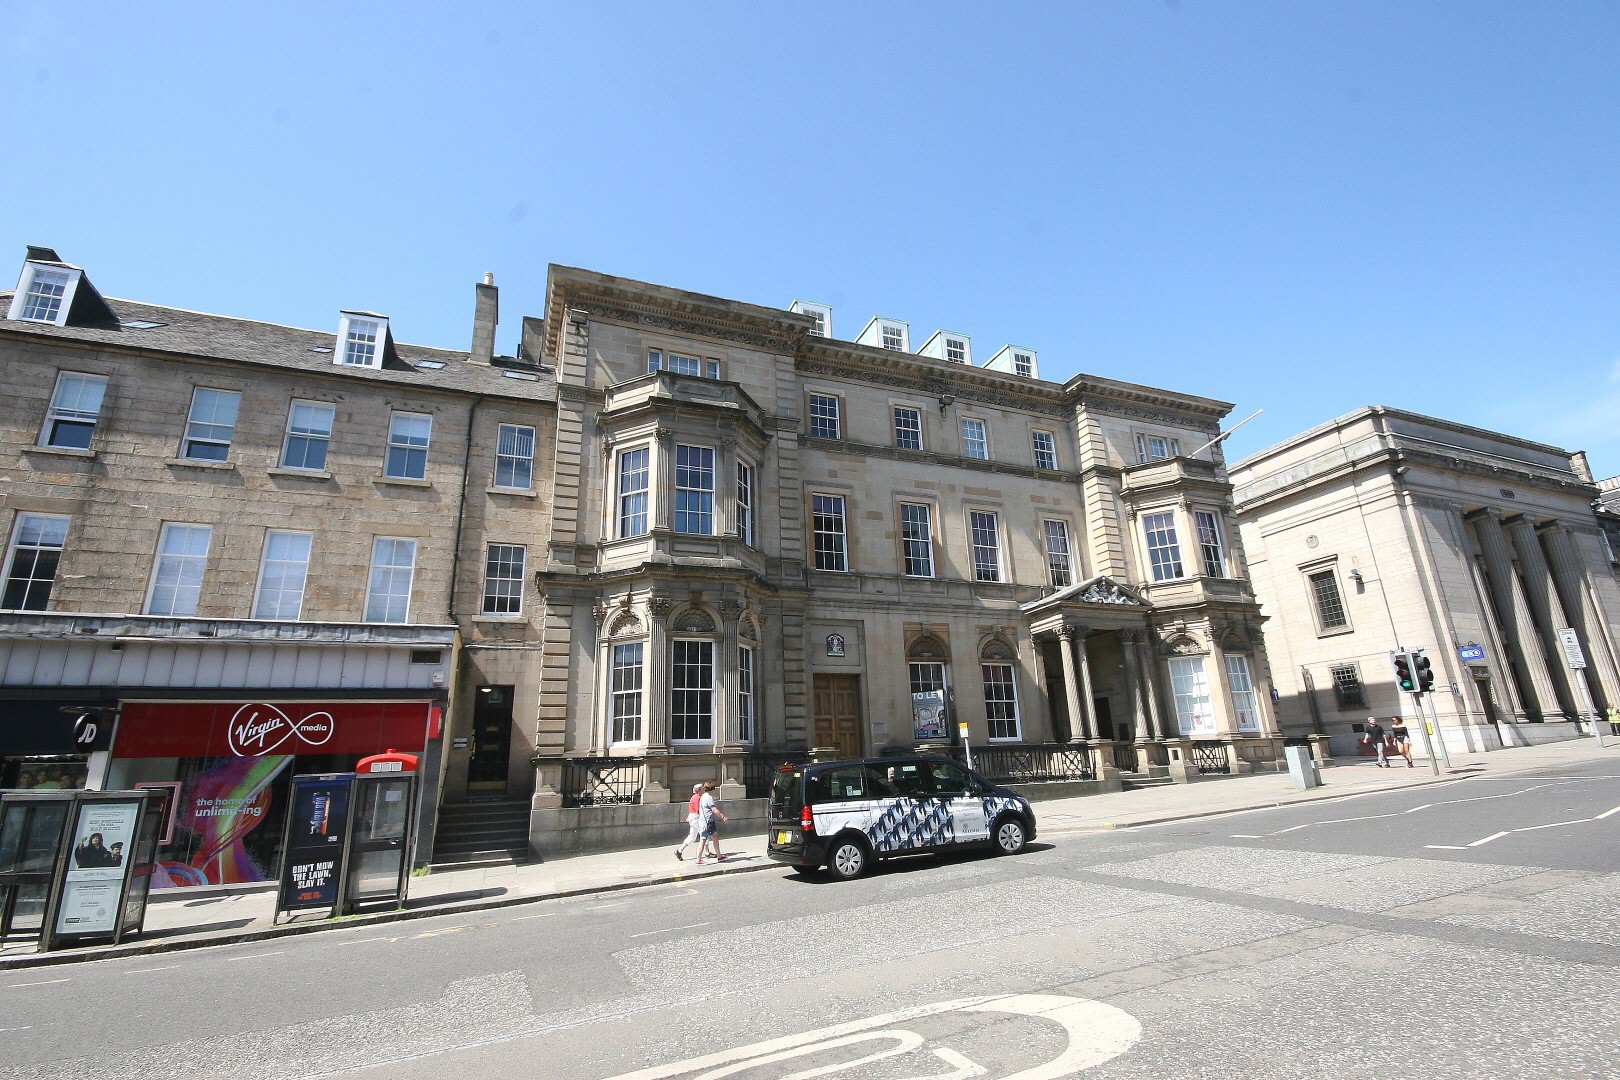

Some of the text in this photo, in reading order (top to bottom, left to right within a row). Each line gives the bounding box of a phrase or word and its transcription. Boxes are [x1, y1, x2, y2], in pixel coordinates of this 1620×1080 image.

[926, 690, 942, 699] LET
[77, 723, 97, 743] JD
[235, 712, 284, 747] Virgin
[196, 796, 257, 806] the home of
[292, 861, 334, 873] DON'T MOW
[293, 870, 331, 882] THE LAWN.
[297, 880, 314, 889] SLAY
